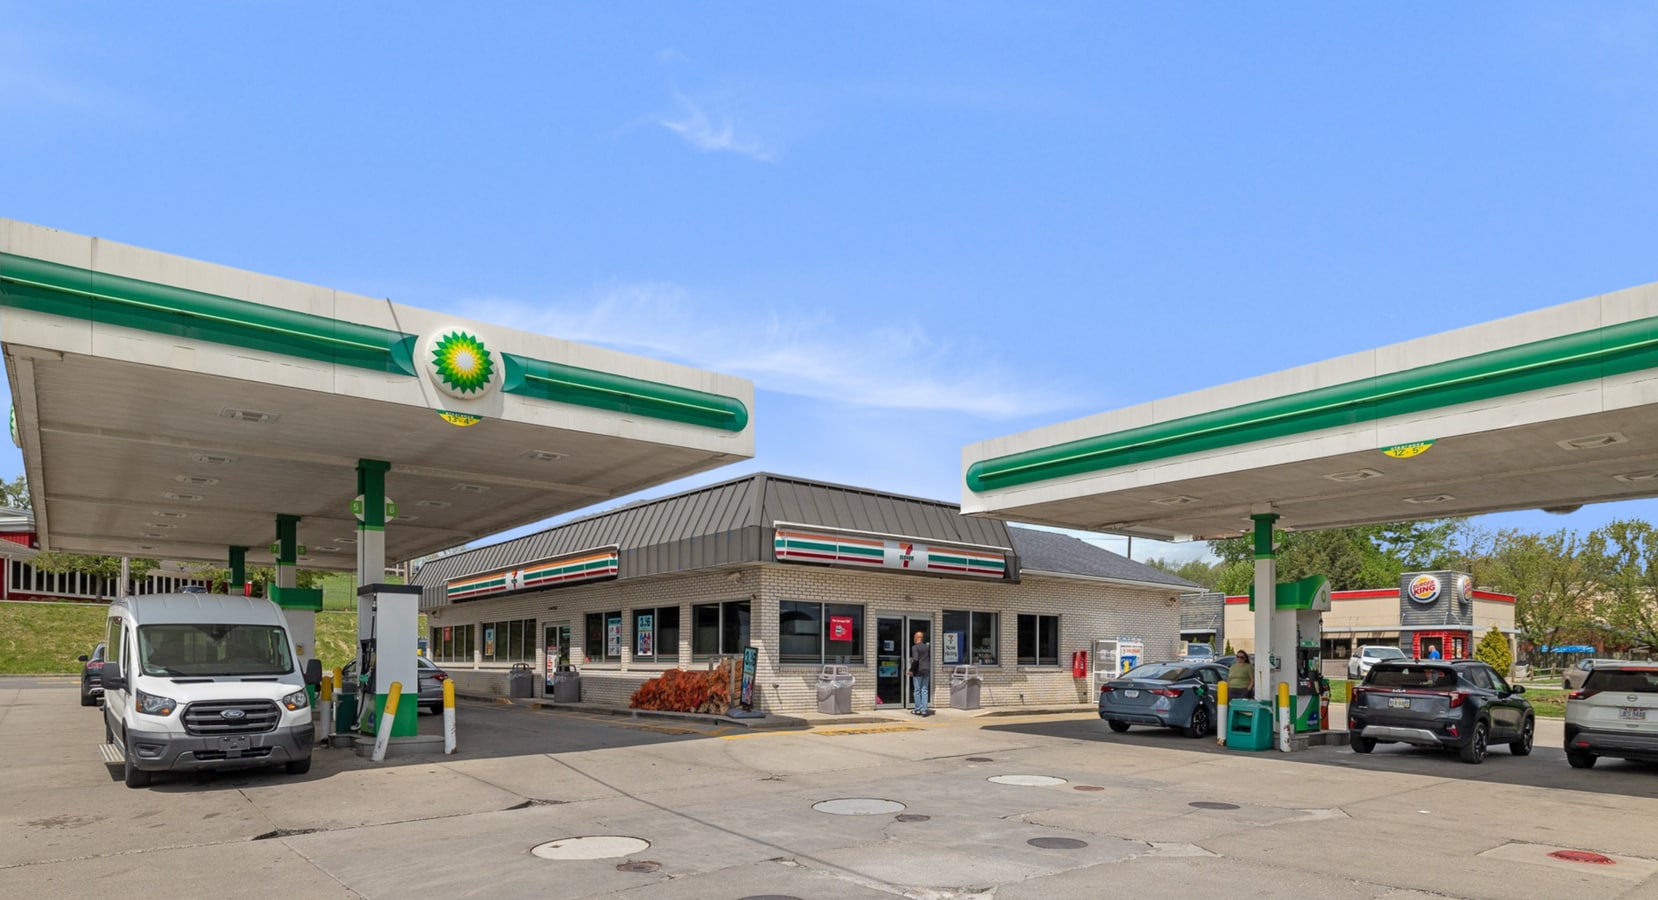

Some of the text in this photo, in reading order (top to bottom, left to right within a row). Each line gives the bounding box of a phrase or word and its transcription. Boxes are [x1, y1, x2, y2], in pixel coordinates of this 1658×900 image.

[353, 503, 359, 511] 5
[1412, 579, 1436, 590] BURGER
[1414, 586, 1436, 596] KING
